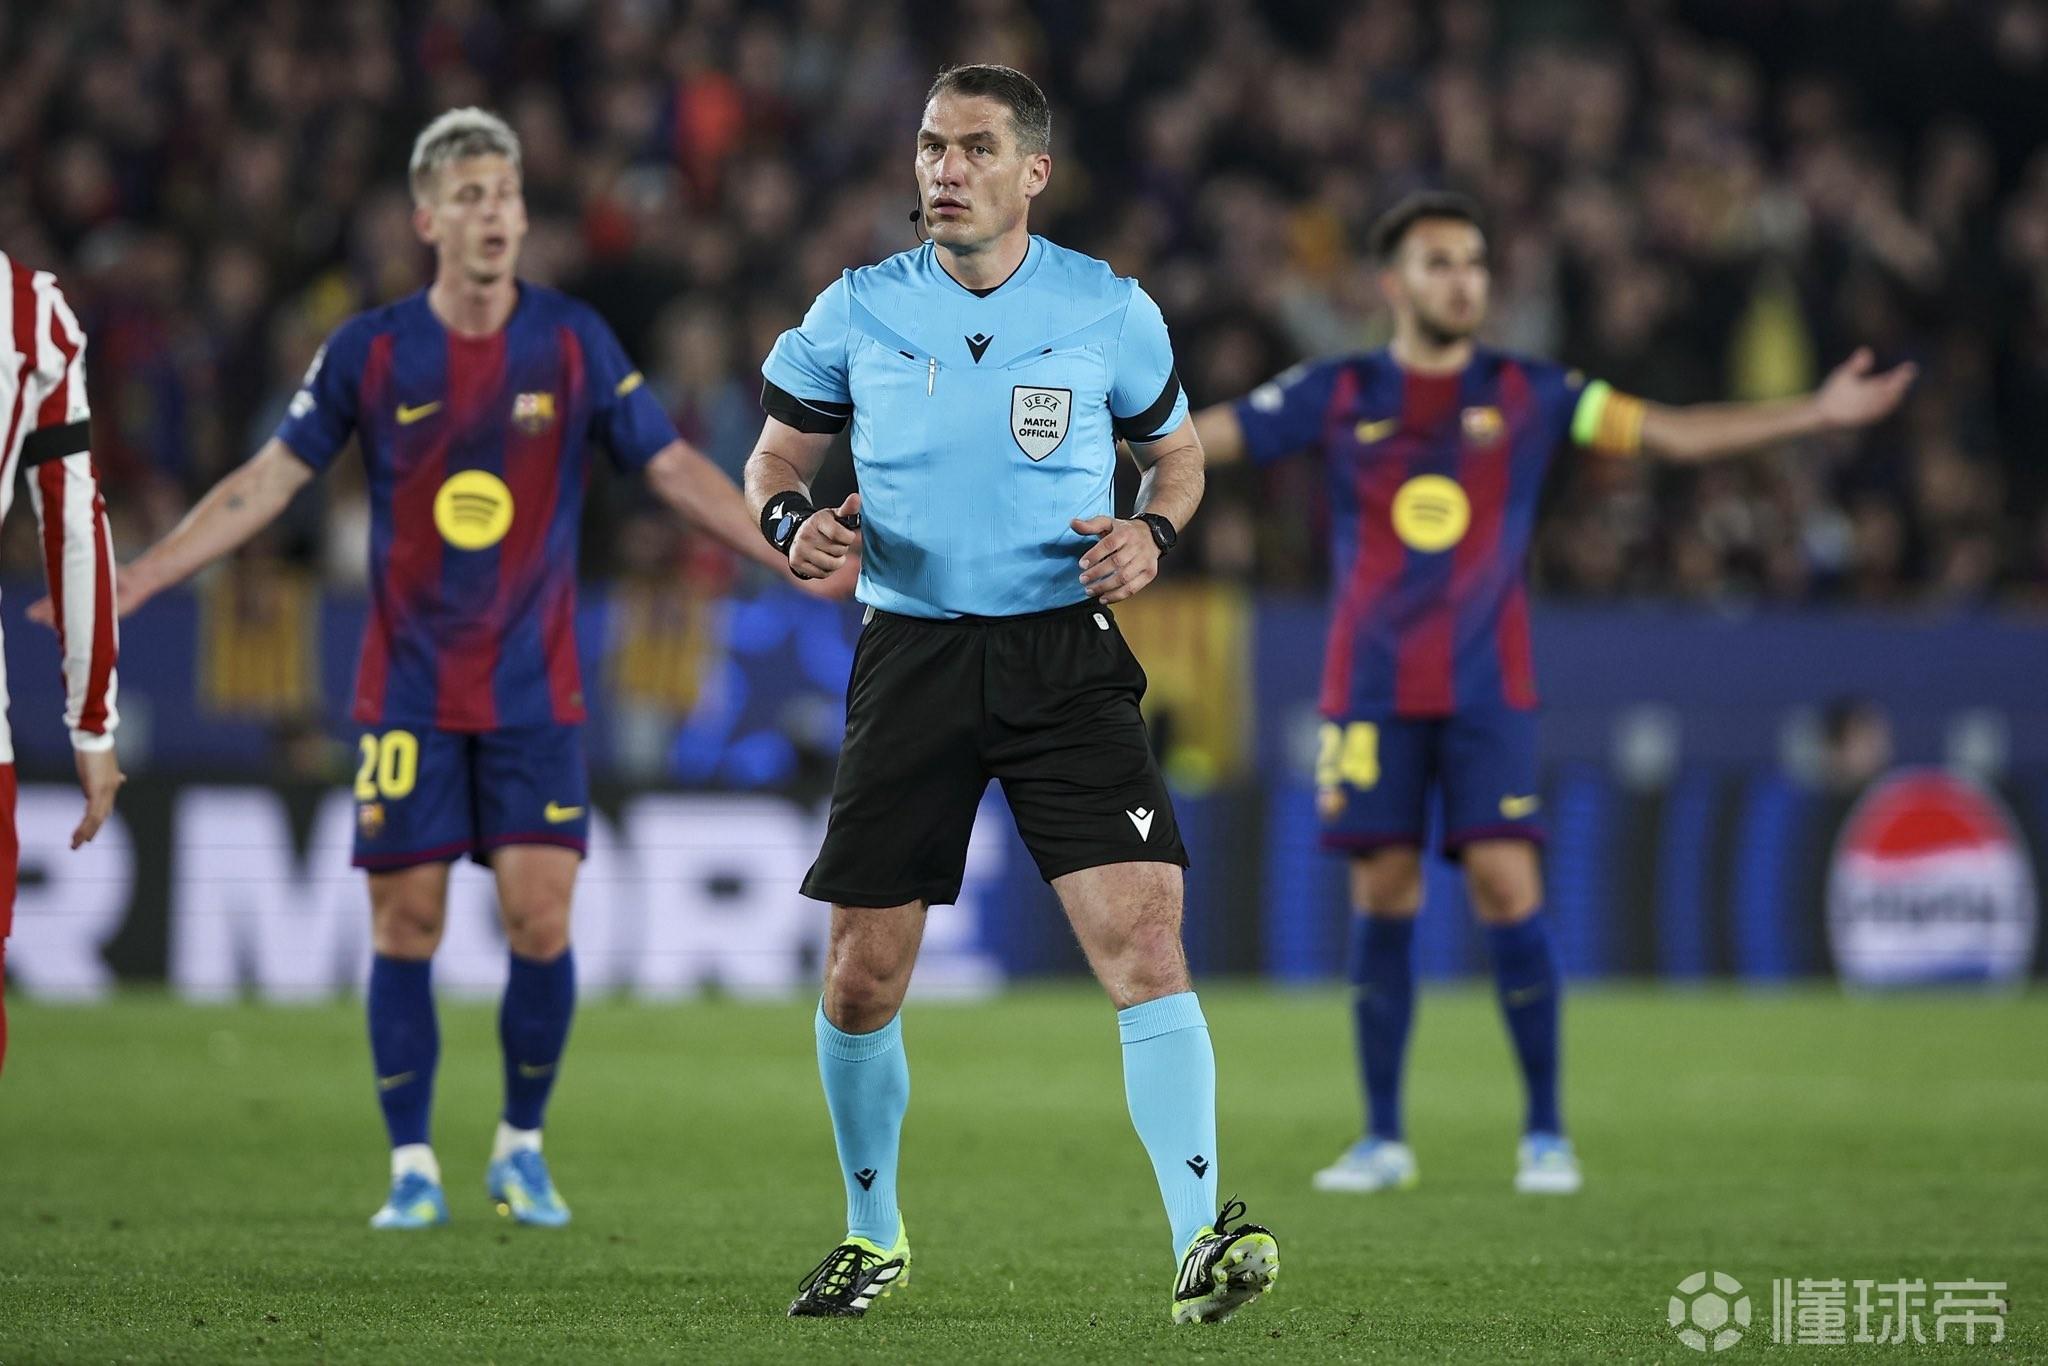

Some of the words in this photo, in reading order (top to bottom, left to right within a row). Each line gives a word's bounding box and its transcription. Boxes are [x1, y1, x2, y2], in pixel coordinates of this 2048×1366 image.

[1024, 396, 1059, 411] UEFA
[1023, 417, 1057, 428] MATCH
[1018, 428, 1060, 439] OFFICIAL
[1316, 721, 1381, 791] 24
[354, 729, 419, 801] 20
